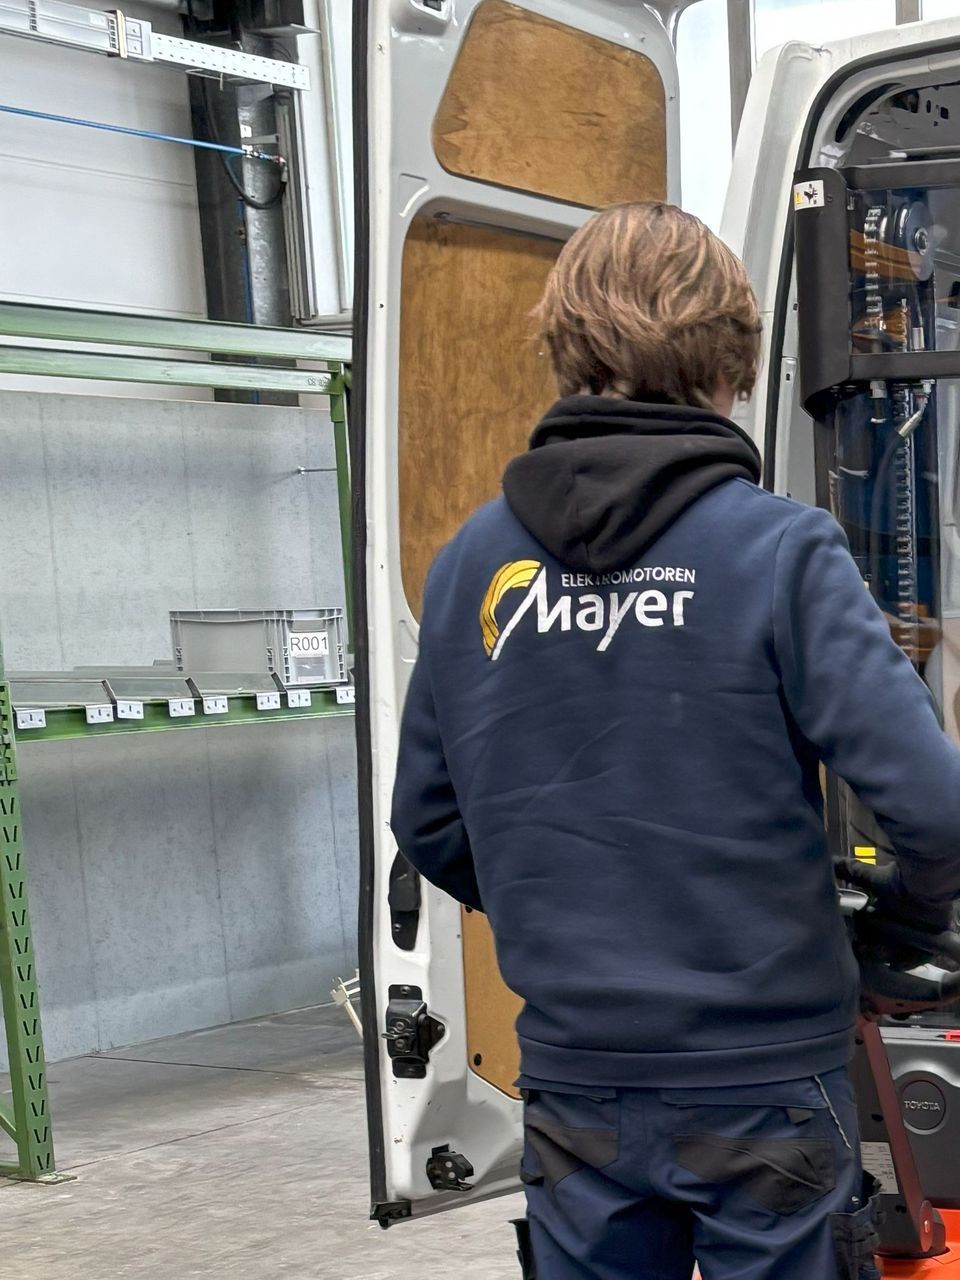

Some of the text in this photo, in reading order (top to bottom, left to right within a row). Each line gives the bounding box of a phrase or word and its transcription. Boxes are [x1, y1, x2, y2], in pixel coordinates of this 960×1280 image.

[491, 565, 695, 661] Mayer
[290, 636, 327, 651] R001
[903, 1100, 941, 1110] TOYOTA
